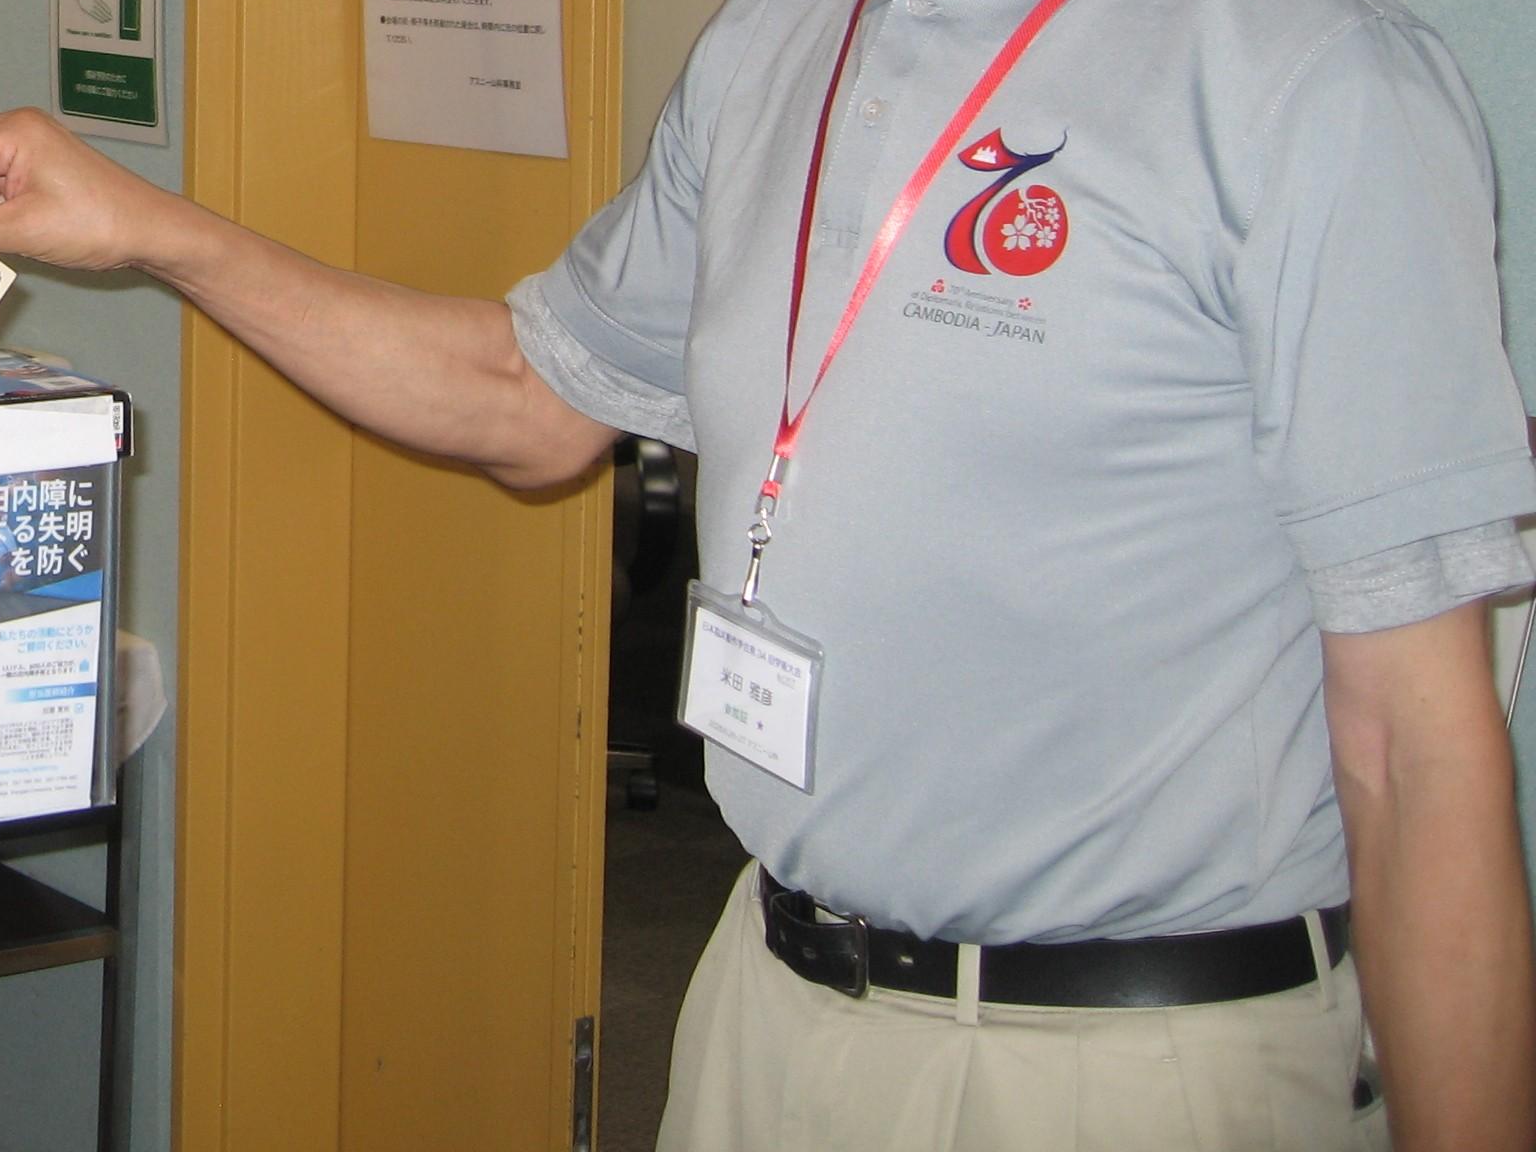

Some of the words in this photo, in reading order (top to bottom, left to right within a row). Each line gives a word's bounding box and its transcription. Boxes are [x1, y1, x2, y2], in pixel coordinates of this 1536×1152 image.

[902, 302, 981, 331] CAMBODIA
[988, 319, 1046, 345] JAPAN
[10, 544, 89, 576] を防ぐ
[720, 667, 743, 691] 米田
